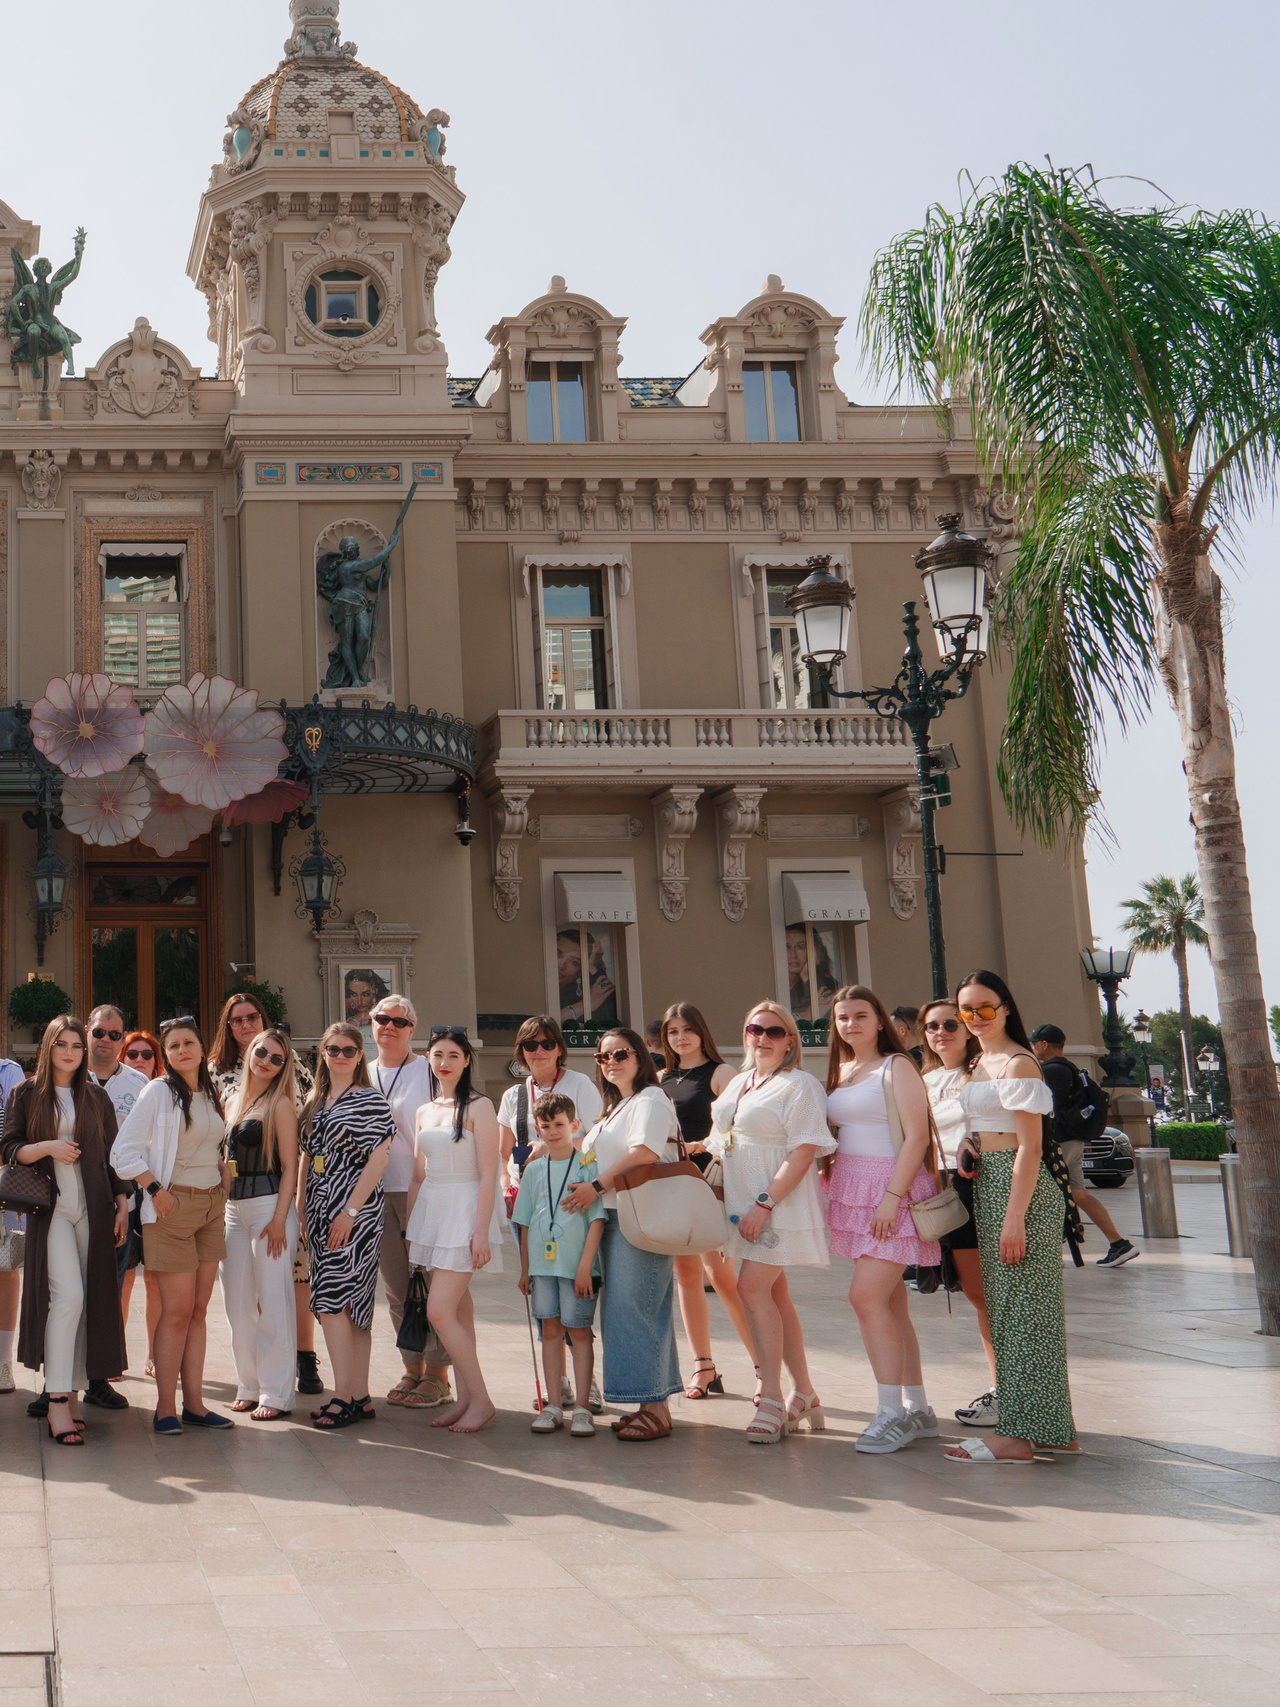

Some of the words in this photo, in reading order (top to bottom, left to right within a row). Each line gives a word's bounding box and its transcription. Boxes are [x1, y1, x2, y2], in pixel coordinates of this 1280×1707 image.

[573, 910, 632, 920] GRAFF
[808, 909, 866, 919] GRAFF
[569, 1034, 602, 1045] GRA
